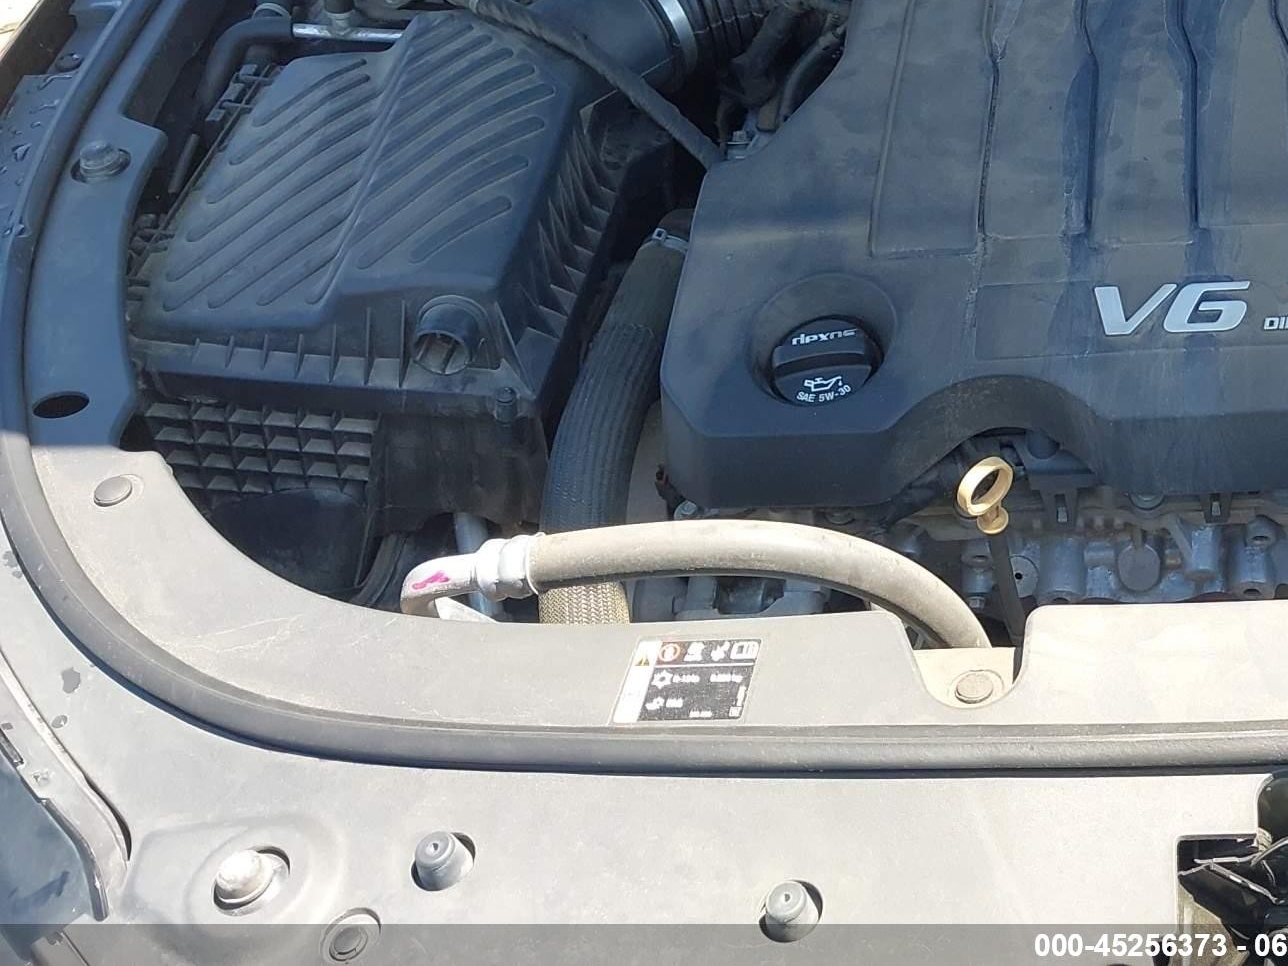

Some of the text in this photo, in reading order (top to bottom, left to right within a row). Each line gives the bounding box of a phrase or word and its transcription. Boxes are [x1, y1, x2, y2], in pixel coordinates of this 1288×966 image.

[1093, 280, 1251, 336] V6
[796, 384, 851, 403] SAE 5W-30
